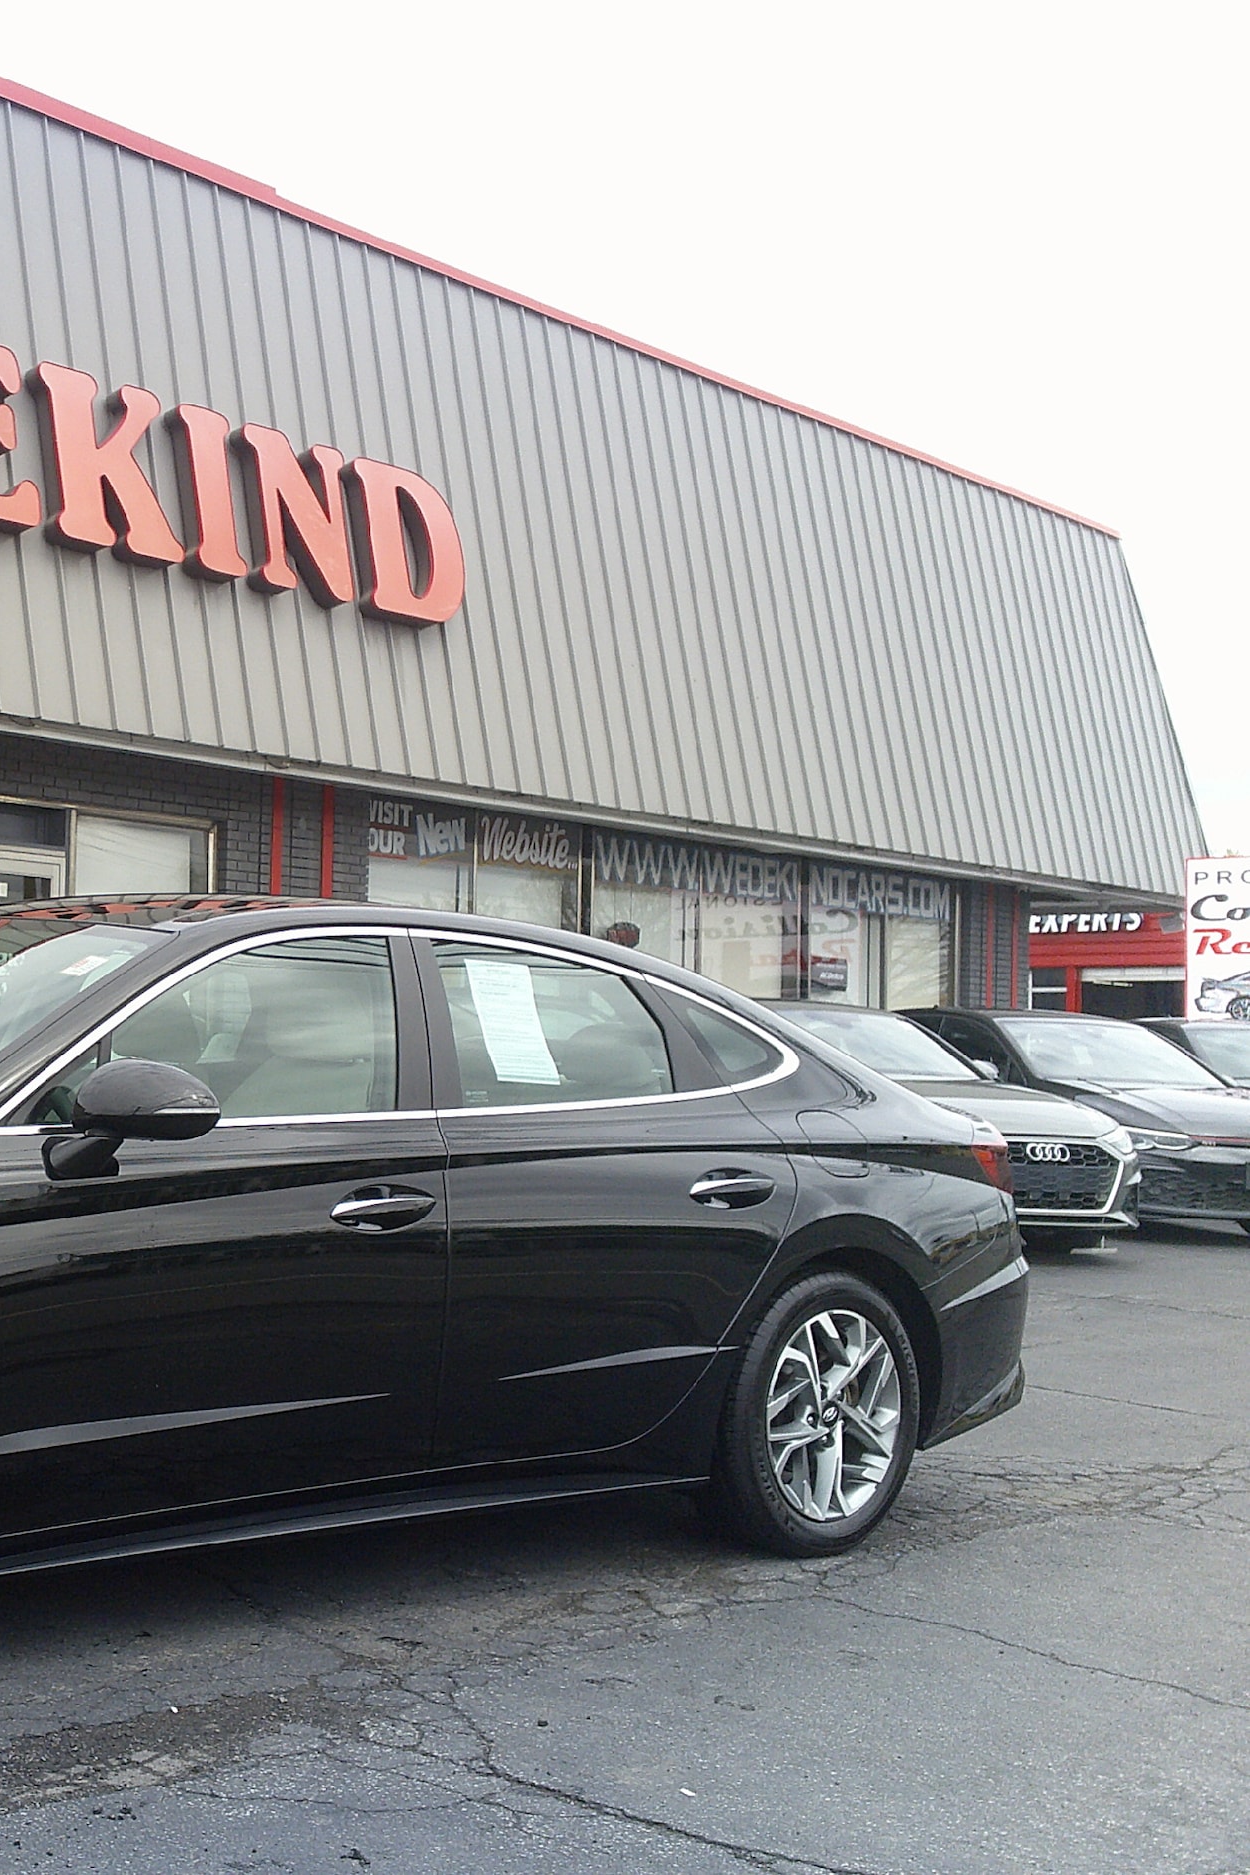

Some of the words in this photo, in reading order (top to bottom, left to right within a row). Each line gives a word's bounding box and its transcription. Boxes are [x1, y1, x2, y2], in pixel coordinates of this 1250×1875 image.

[368, 800, 413, 827] VISIT
[368, 828, 405, 855] OUR
[417, 812, 466, 858] New
[1029, 912, 1142, 934] EXPERTS
